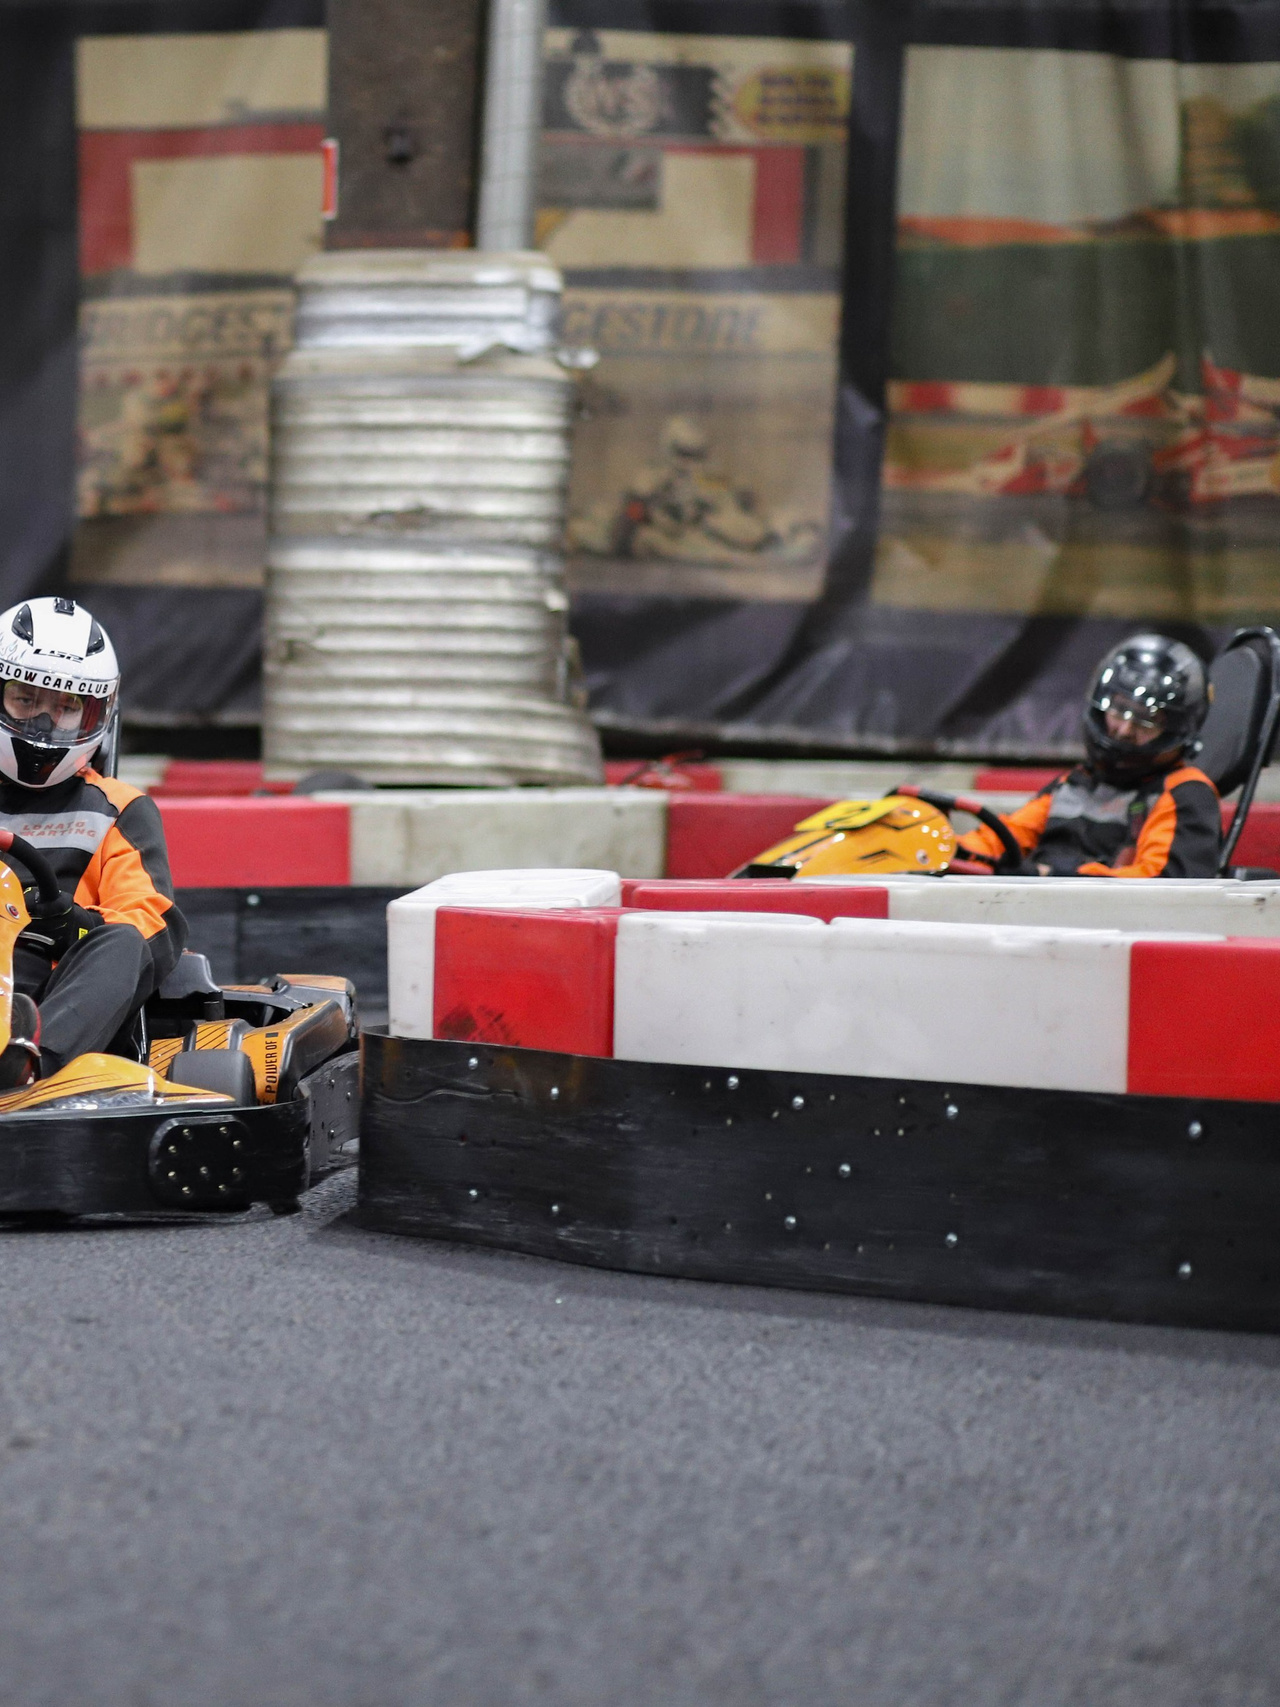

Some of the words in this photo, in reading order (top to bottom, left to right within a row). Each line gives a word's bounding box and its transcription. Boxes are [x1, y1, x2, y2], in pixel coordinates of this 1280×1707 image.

[42, 676, 73, 690] CAR
[78, 682, 108, 694] CLUB
[23, 821, 86, 831] LONATO
[21, 828, 96, 837] KARTING
[265, 1041, 277, 1050] OF
[265, 1052, 277, 1094] POWER
